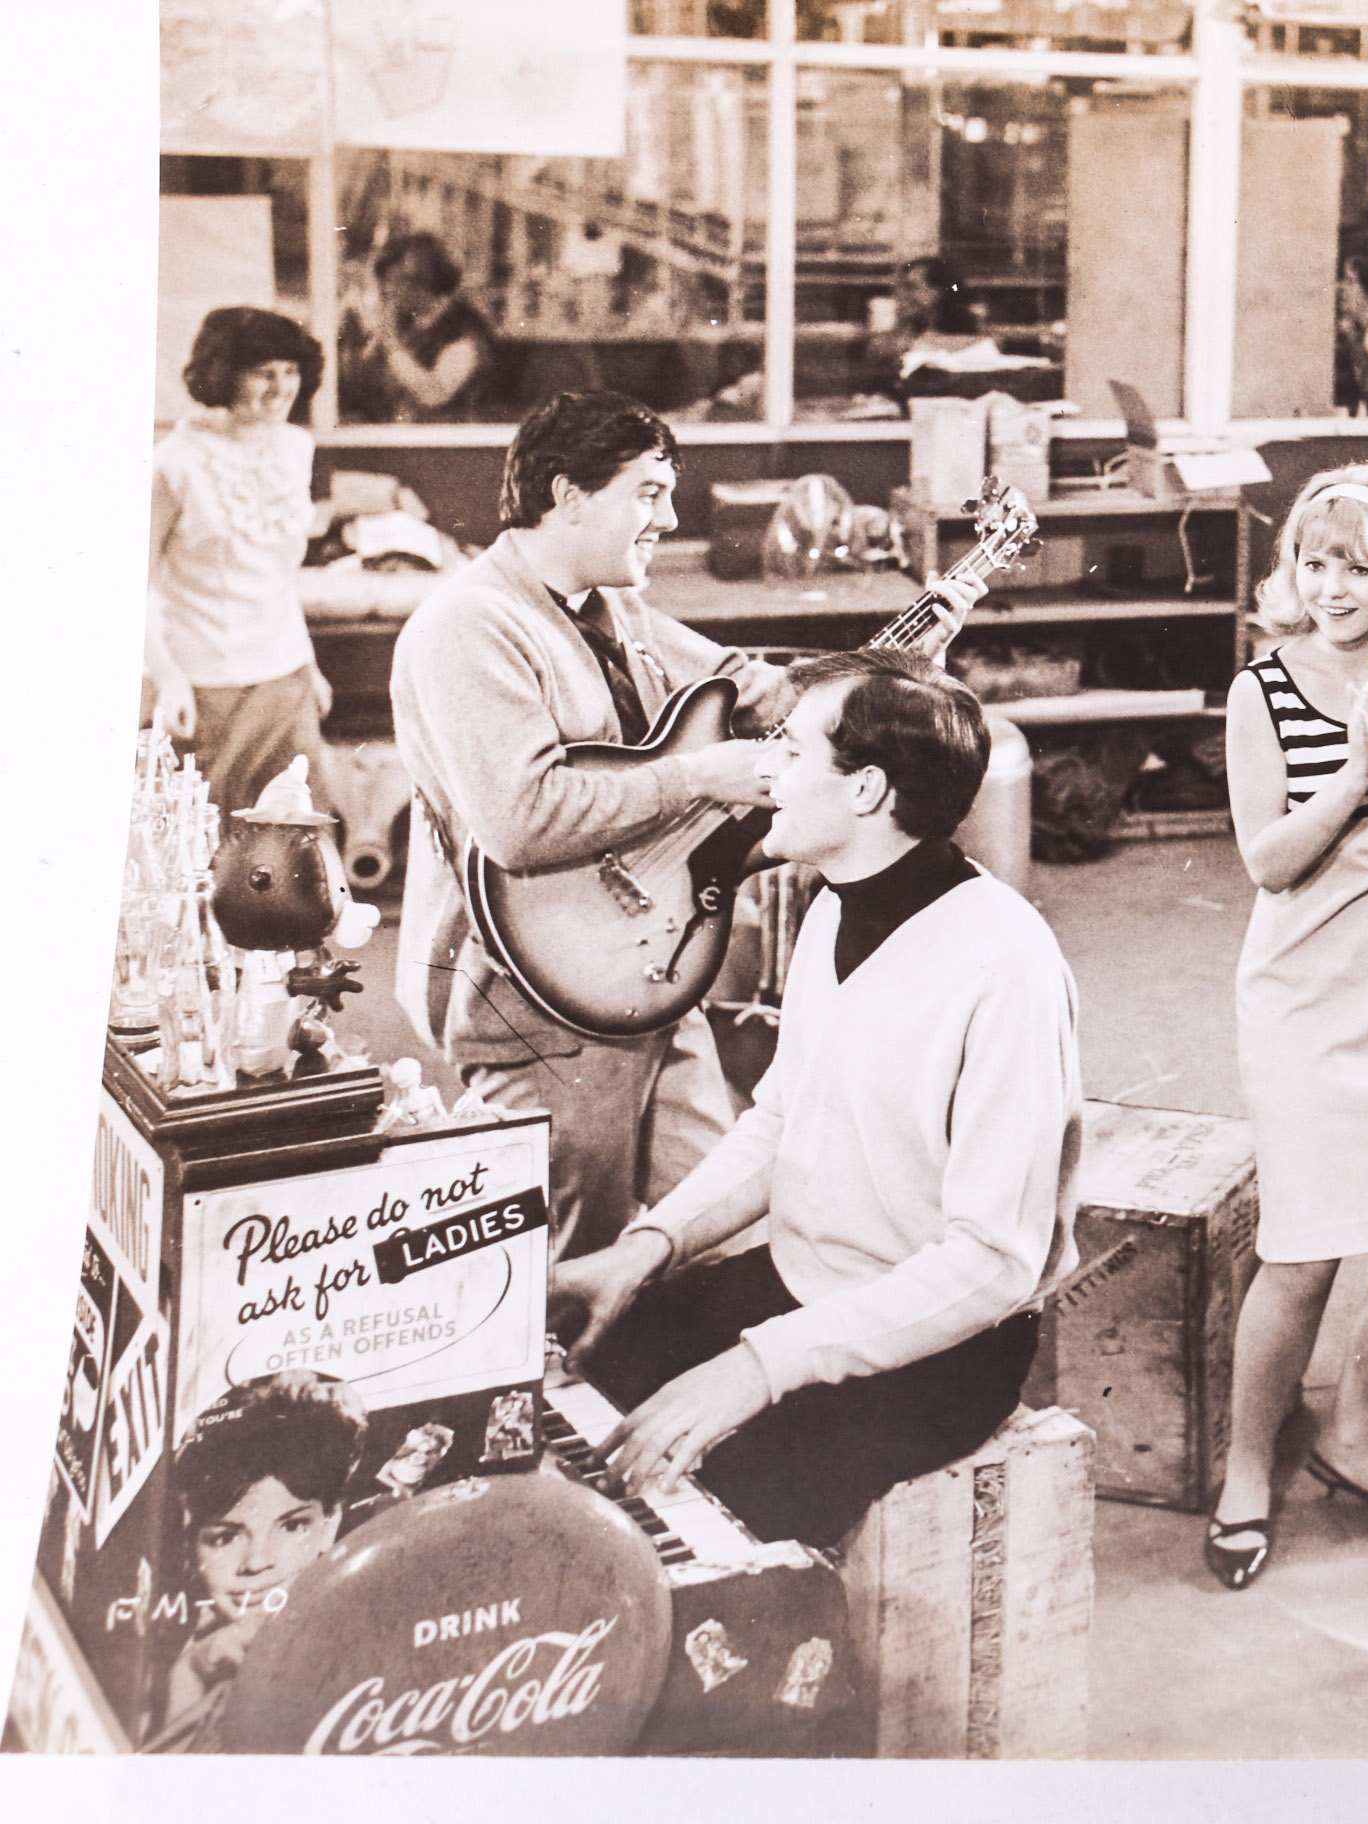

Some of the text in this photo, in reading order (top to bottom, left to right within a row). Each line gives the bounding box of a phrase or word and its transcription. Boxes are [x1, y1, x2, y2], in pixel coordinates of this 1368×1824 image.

[222, 1161, 490, 1286] Please do not
[238, 1203, 526, 1325] ask for LADIES
[266, 1320, 457, 1371] OFTEN OFFENDS
[283, 1302, 444, 1348] AS A REFUSAL
[104, 1332, 161, 1504] EXIT
[413, 1597, 522, 1649] DRINK
[303, 1614, 619, 1756] Coca-Cola
